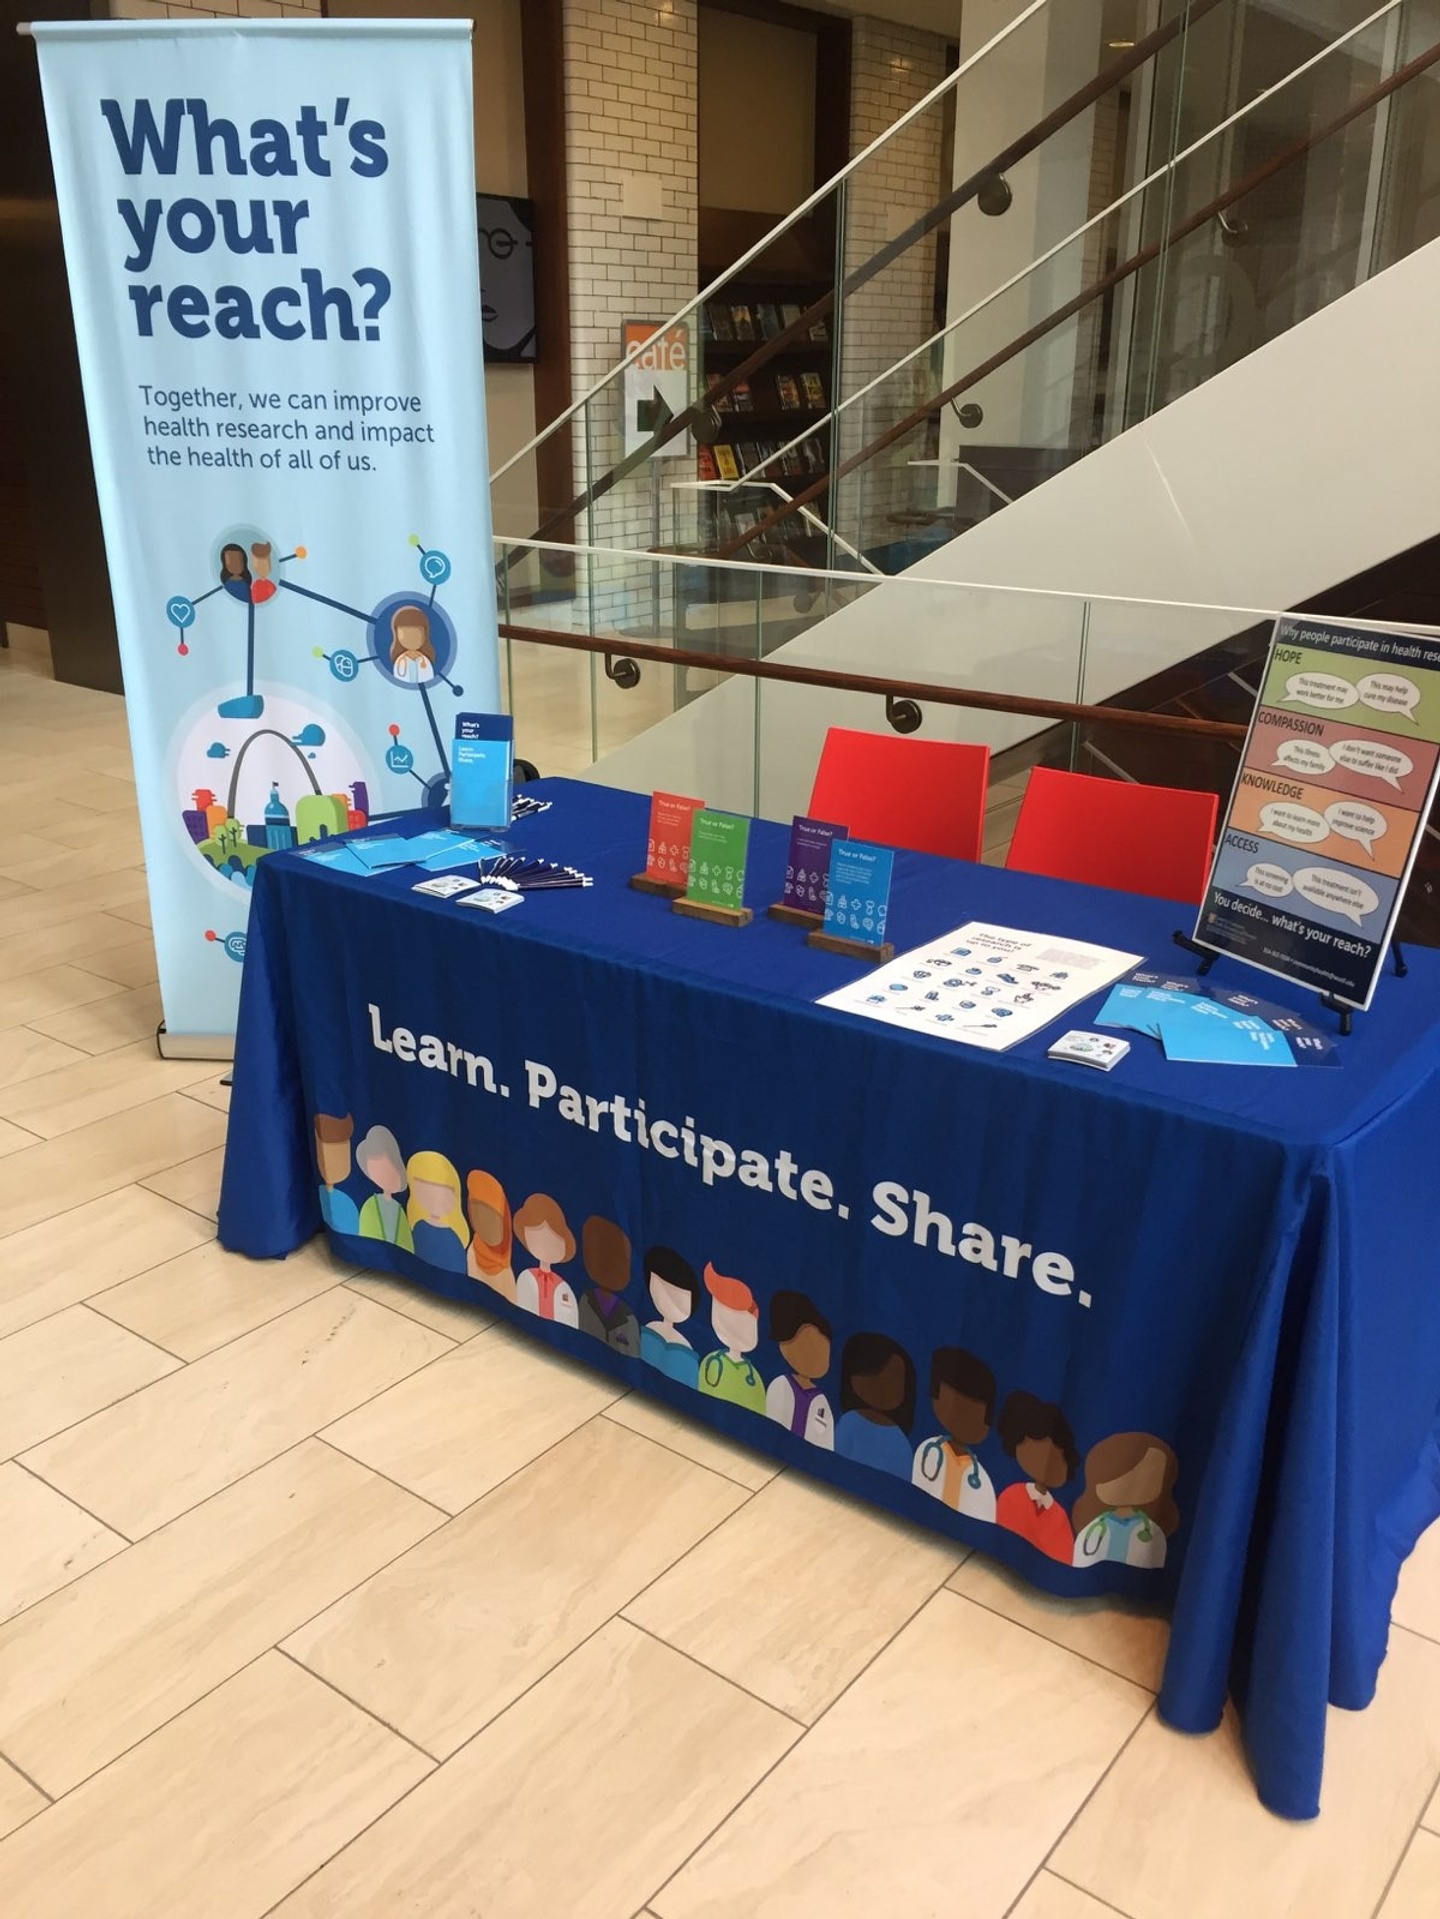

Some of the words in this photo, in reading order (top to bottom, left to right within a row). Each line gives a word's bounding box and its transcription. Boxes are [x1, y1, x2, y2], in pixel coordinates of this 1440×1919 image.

[100, 97, 389, 178] What's
[116, 197, 309, 273] your
[128, 267, 392, 341] reach?
[626, 329, 686, 370] café
[138, 385, 242, 411] Together,
[249, 393, 281, 409] we
[288, 394, 327, 410] can
[333, 390, 421, 416] improve
[144, 415, 209, 437] health
[216, 419, 308, 440] research
[315, 421, 354, 441] and
[360, 421, 434, 447] impact
[147, 446, 181, 466] the
[187, 447, 253, 468] health
[259, 449, 282, 468] of
[288, 449, 313, 469] all
[319, 450, 340, 470] of
[347, 453, 376, 471] us.
[1274, 648, 1302, 664] HOPE
[1281, 624, 1299, 641] Why
[1300, 627, 1330, 645] people
[1331, 634, 1379, 652] participate
[1381, 641, 1390, 653] in
[1392, 642, 1421, 658] health
[1384, 684, 1395, 694] may
[1397, 686, 1408, 695] help
[1258, 711, 1324, 736] COMPASSION
[1241, 773, 1304, 800] KNOWLEDGE
[1226, 834, 1259, 854] ACCESS
[1214, 892, 1230, 908] You
[1231, 899, 1269, 922] decide...
[1272, 914, 1304, 935] what's
[1305, 927, 1331, 943] your
[1333, 935, 1371, 958] reach?
[368, 1003, 510, 1098] Learn.
[524, 1059, 849, 1220] Participate.
[870, 1180, 1092, 1308] Share.
